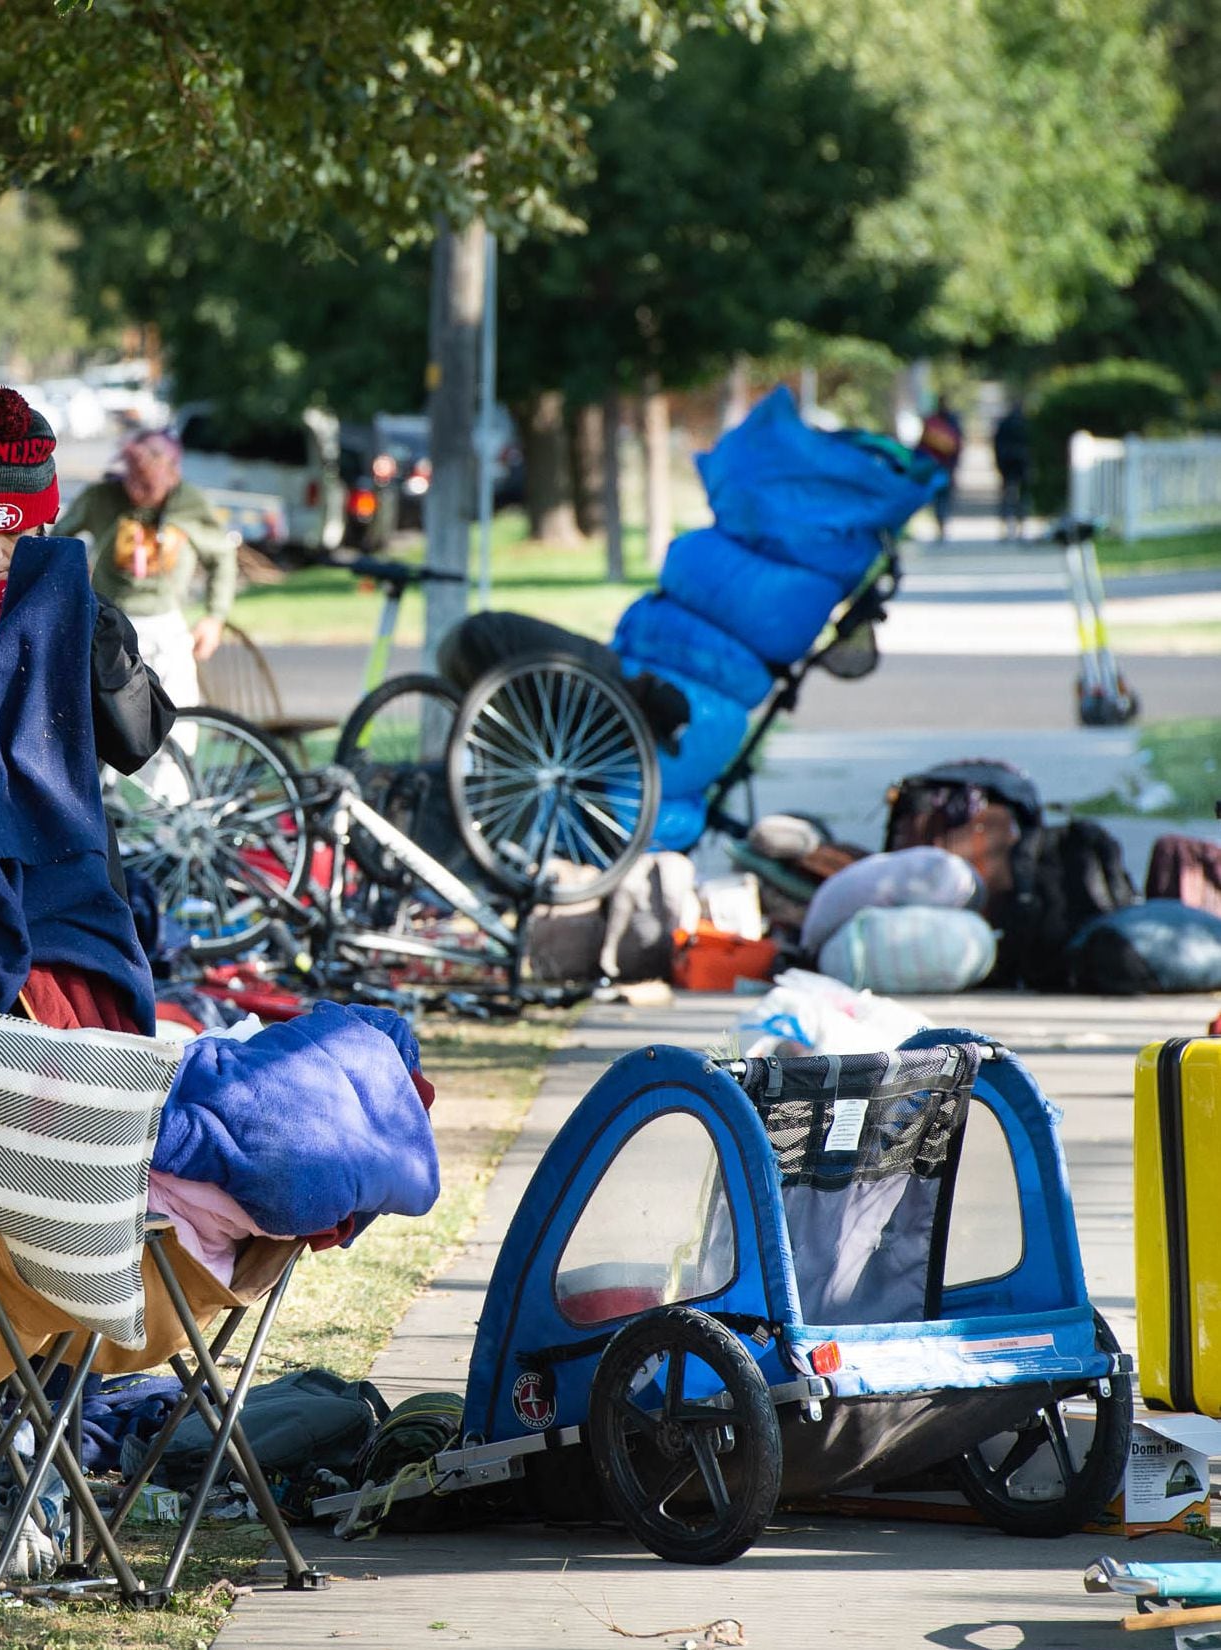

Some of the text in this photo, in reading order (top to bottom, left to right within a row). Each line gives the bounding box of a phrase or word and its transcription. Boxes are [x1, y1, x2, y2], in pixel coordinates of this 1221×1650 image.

[520, 1412, 553, 1427] QUALITY
[1131, 1441, 1184, 1455] Dome Tent
